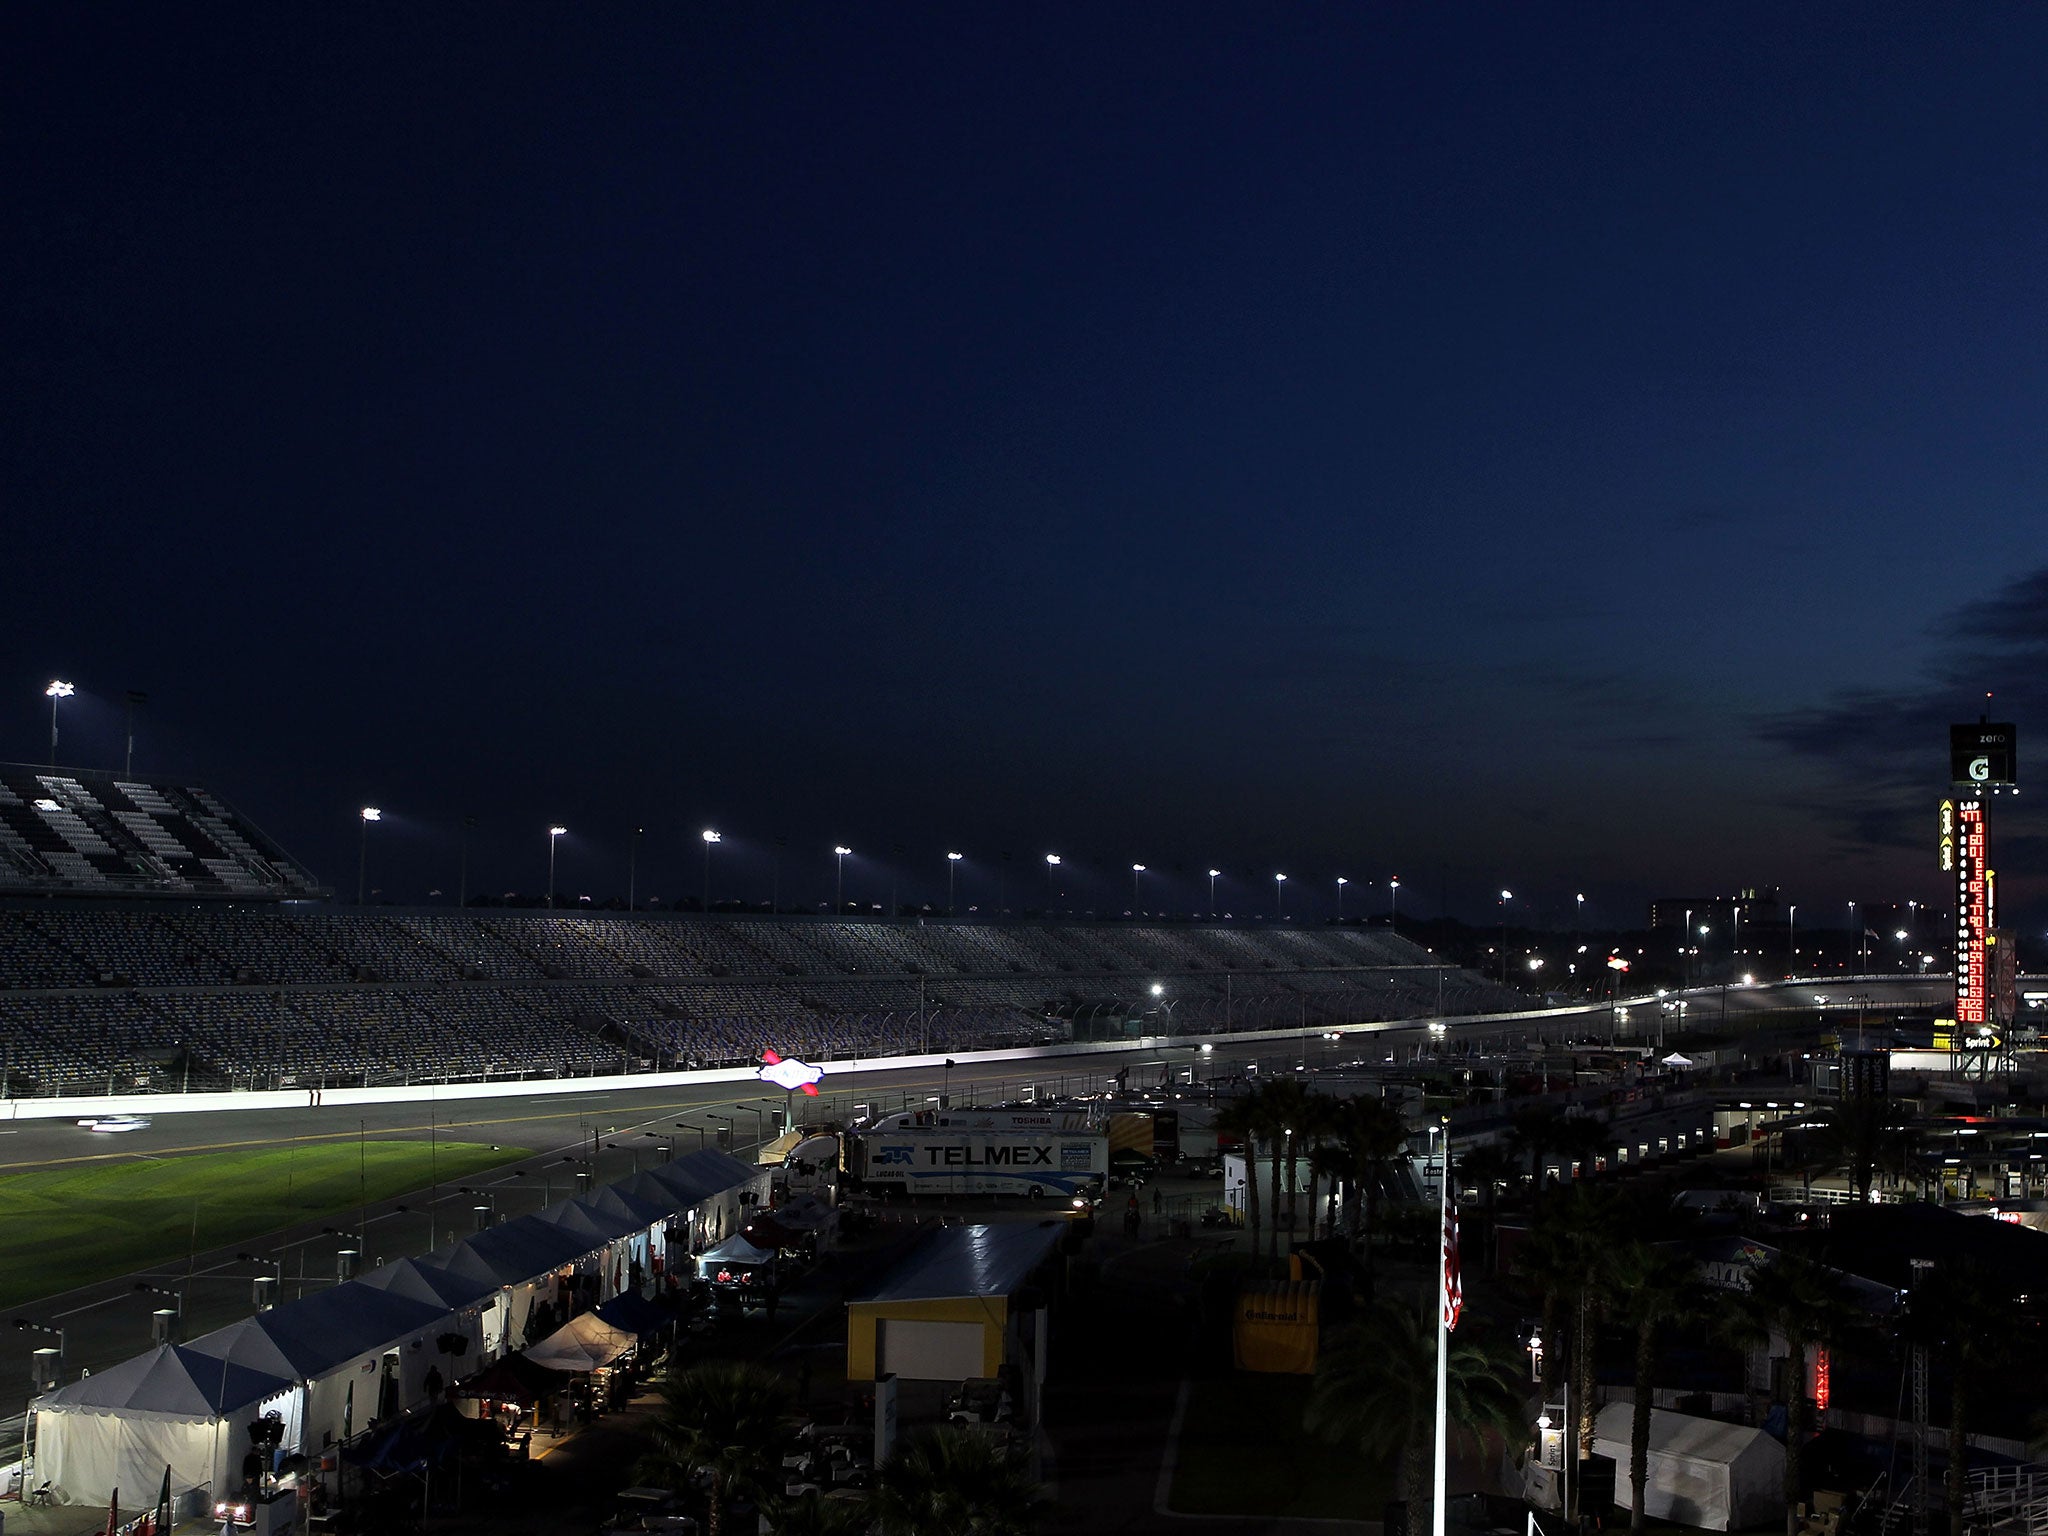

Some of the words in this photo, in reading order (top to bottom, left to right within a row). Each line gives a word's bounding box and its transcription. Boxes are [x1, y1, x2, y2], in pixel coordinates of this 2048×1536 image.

[1979, 734, 2006, 743] zero
[1969, 756, 1989, 781] G
[1960, 802, 1980, 811] LAP
[1960, 811, 1981, 822] 477
[1975, 822, 1983, 834] 8
[1969, 834, 1983, 845] 60
[1969, 846, 1983, 857] 01
[1975, 858, 1983, 869] 6
[1975, 869, 1983, 880] 5
[1969, 881, 1983, 893] 02
[1975, 893, 1983, 904] 2
[1969, 904, 1983, 916] 77
[1969, 916, 1983, 928] 90
[1975, 928, 1983, 939] 9
[1969, 939, 1983, 951] 44
[1969, 951, 1983, 963] 59
[1969, 963, 1983, 974] 57
[1969, 975, 1983, 986] 67
[1969, 986, 1983, 998] 63
[1957, 998, 1983, 1010] 3022
[1965, 1036, 1991, 1049] Sprint
[1847, 1057, 1855, 1092] Sprint
[1872, 1057, 1885, 1094] Sprint
[1012, 1117, 1051, 1125] TOSHIBA
[924, 1146, 1053, 1166] TELMEX
[1549, 1444, 1557, 1467] Sprint
